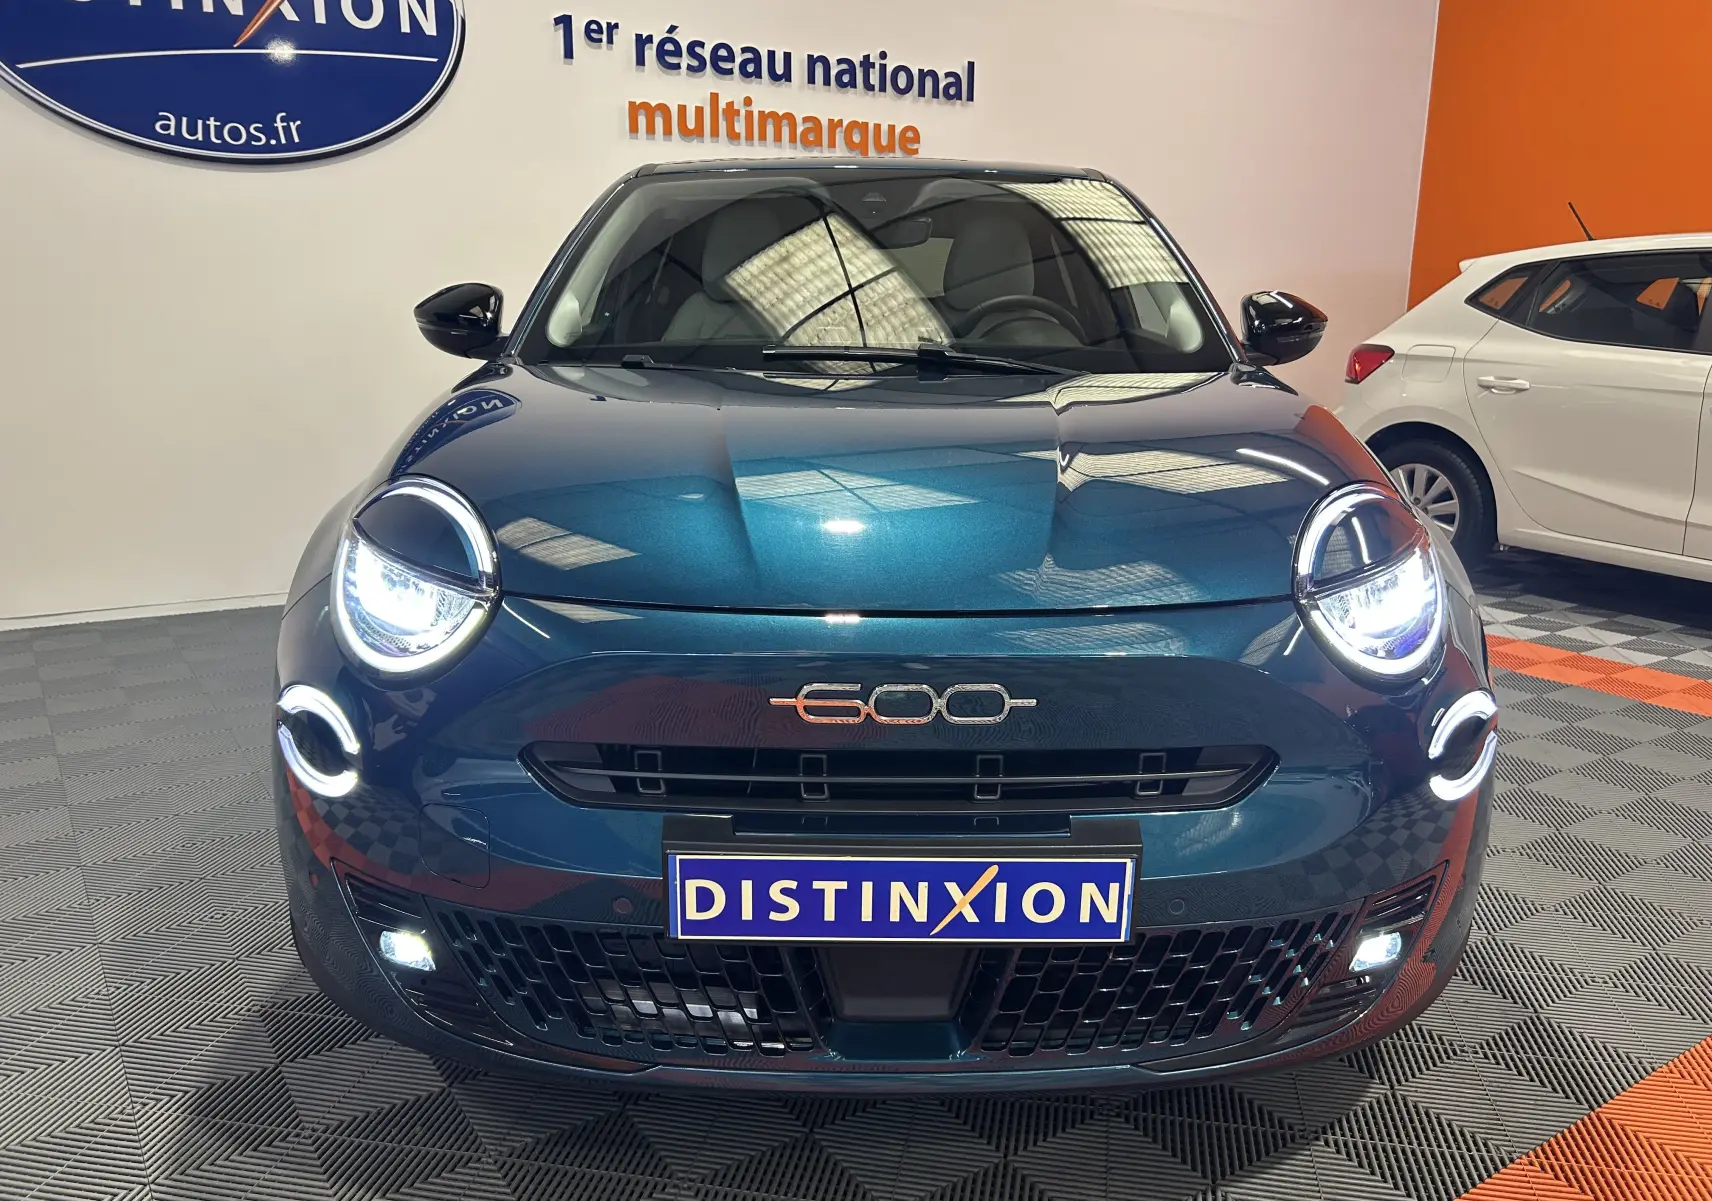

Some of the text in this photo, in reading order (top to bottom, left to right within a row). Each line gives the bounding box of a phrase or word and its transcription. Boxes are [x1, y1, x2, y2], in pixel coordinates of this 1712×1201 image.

[635, 24, 792, 82] réseau
[806, 51, 975, 102] national
[154, 111, 301, 146] autos.fr
[628, 92, 920, 156] multimarque
[796, 683, 1012, 725] 600
[684, 865, 1120, 936] DISTINXION
